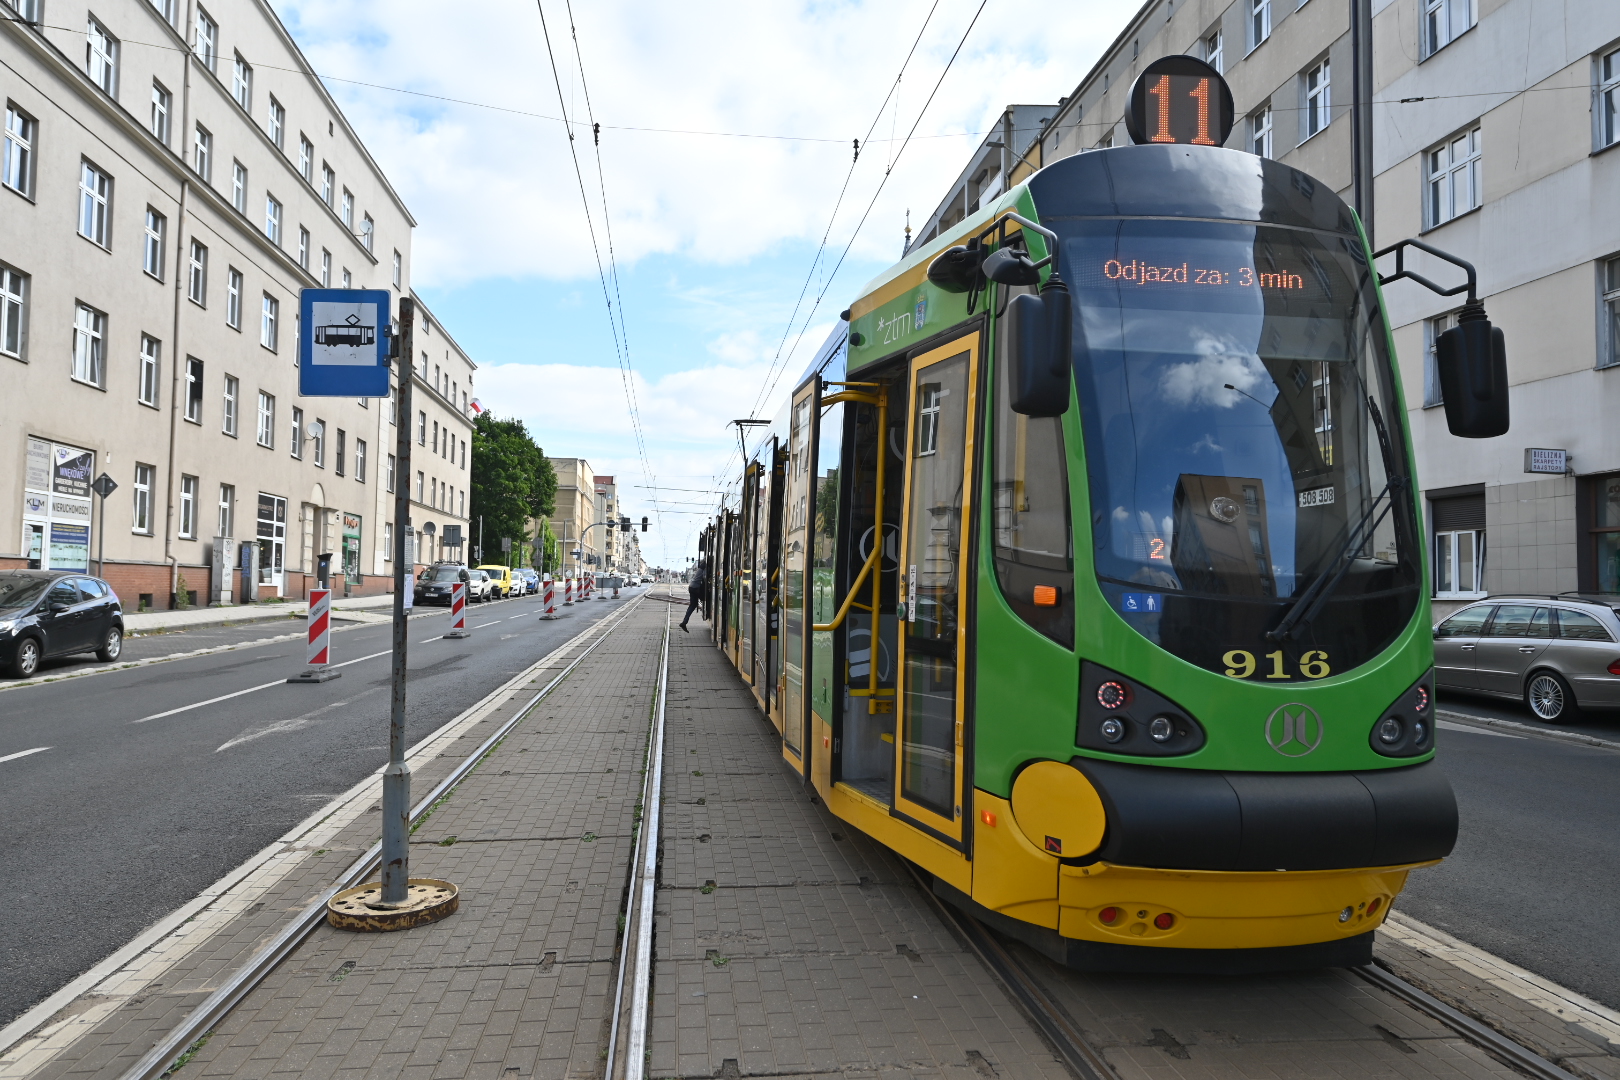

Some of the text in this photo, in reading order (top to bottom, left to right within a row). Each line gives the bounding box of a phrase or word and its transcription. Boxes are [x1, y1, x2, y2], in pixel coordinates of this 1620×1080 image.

[1149, 74, 1216, 146] 11
[1104, 259, 1304, 289] Odjazd za: 3 min
[1533, 450, 1562, 459] BIELIZNA
[26, 498, 45, 507] KLM
[1318, 488, 1334, 503] 508
[52, 502, 89, 516] NIERUCHOMOŚCI
[1150, 538, 1165, 559] 2
[1222, 649, 1331, 679] 916
